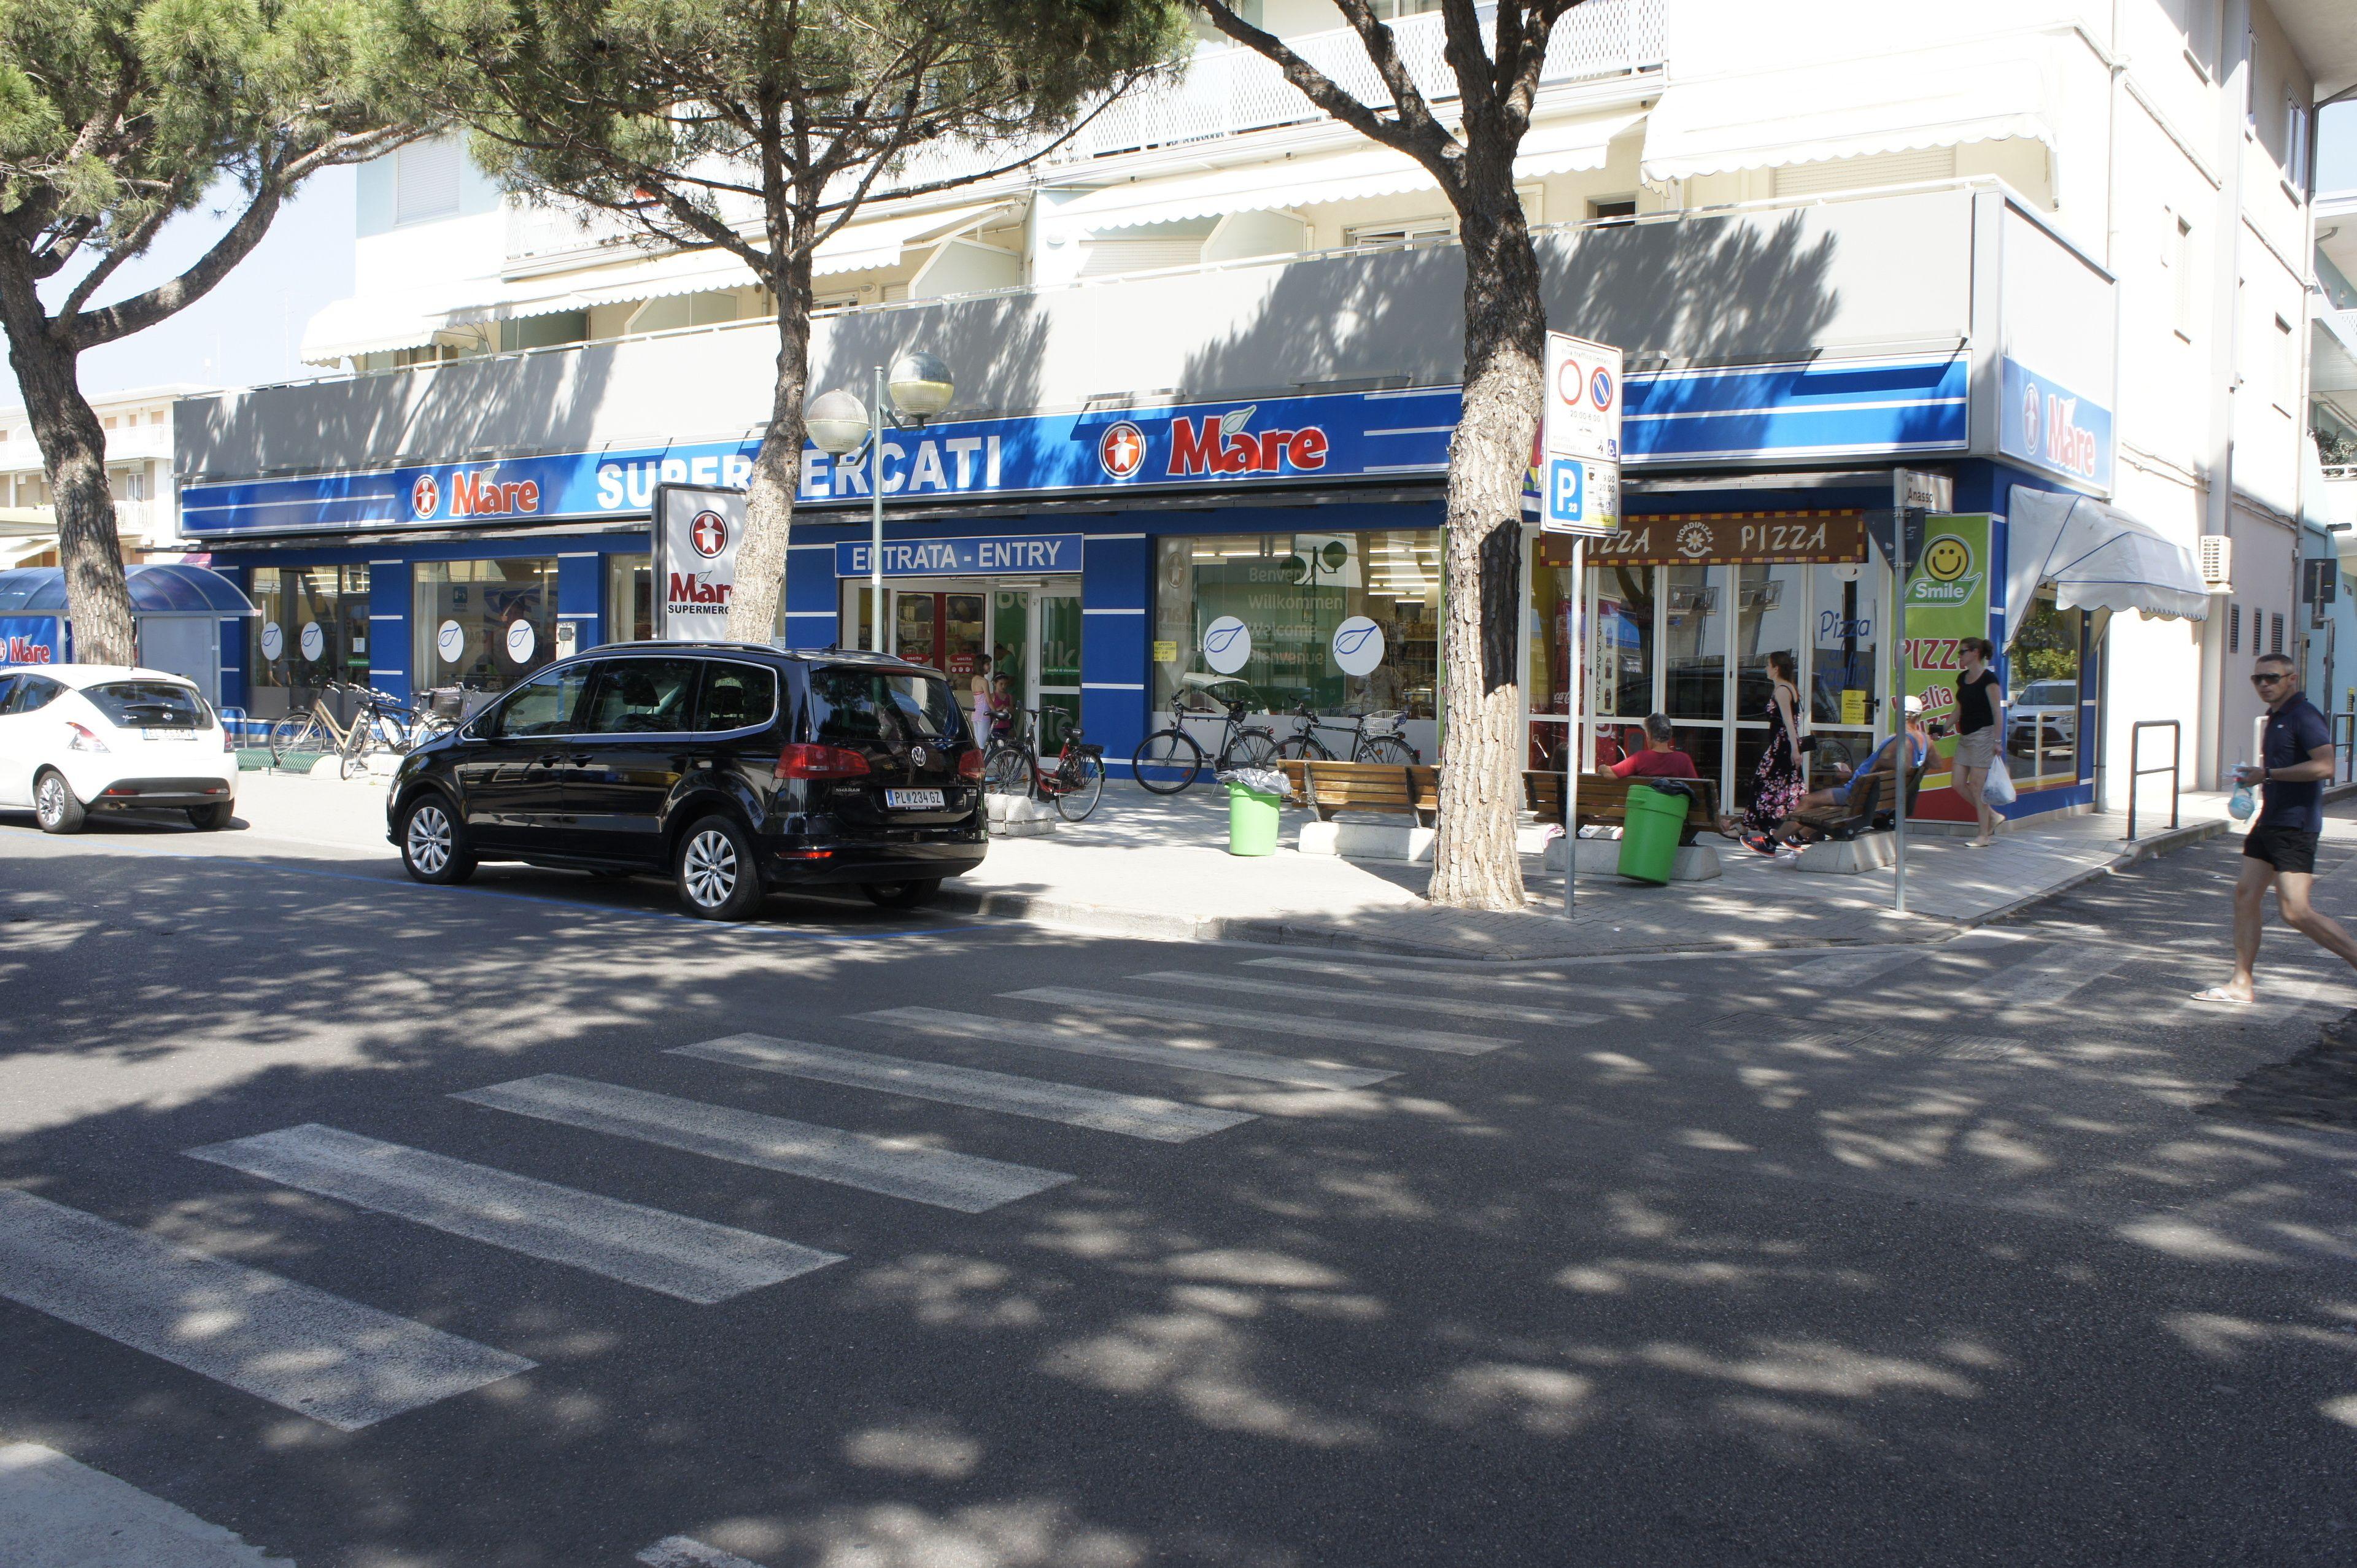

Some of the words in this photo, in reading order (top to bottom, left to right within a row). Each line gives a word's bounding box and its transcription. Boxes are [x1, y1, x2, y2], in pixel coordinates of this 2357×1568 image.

[1573, 350, 1592, 361] traffico
[1166, 415, 1328, 476] Mare
[2046, 393, 2096, 477] Mare
[597, 434, 1000, 510] SUPERERCATI
[449, 471, 540, 517] Mare
[1557, 468, 1576, 512] P
[1908, 487, 1933, 503] Anasso
[1568, 503, 1577, 513] 23
[1587, 527, 1650, 555] IZZA
[1676, 522, 1714, 543] FIORDIPIZZA
[1740, 522, 1827, 552] PIZZA
[979, 541, 1062, 568] ENTRY
[669, 573, 733, 604] Mar
[1248, 594, 1343, 609] Willkommen
[1916, 582, 1965, 598] Smile
[668, 605, 729, 614] SUPERMERC
[1248, 622, 1317, 637] Welcome
[1820, 610, 1870, 641] Pizza
[10, 636, 50, 664] Mare
[1894, 638, 1967, 670] PIZZ
[1819, 651, 1868, 694] taglio
[894, 791, 907, 804] PL
[911, 791, 929, 804] 234
[930, 791, 942, 803] GZ
